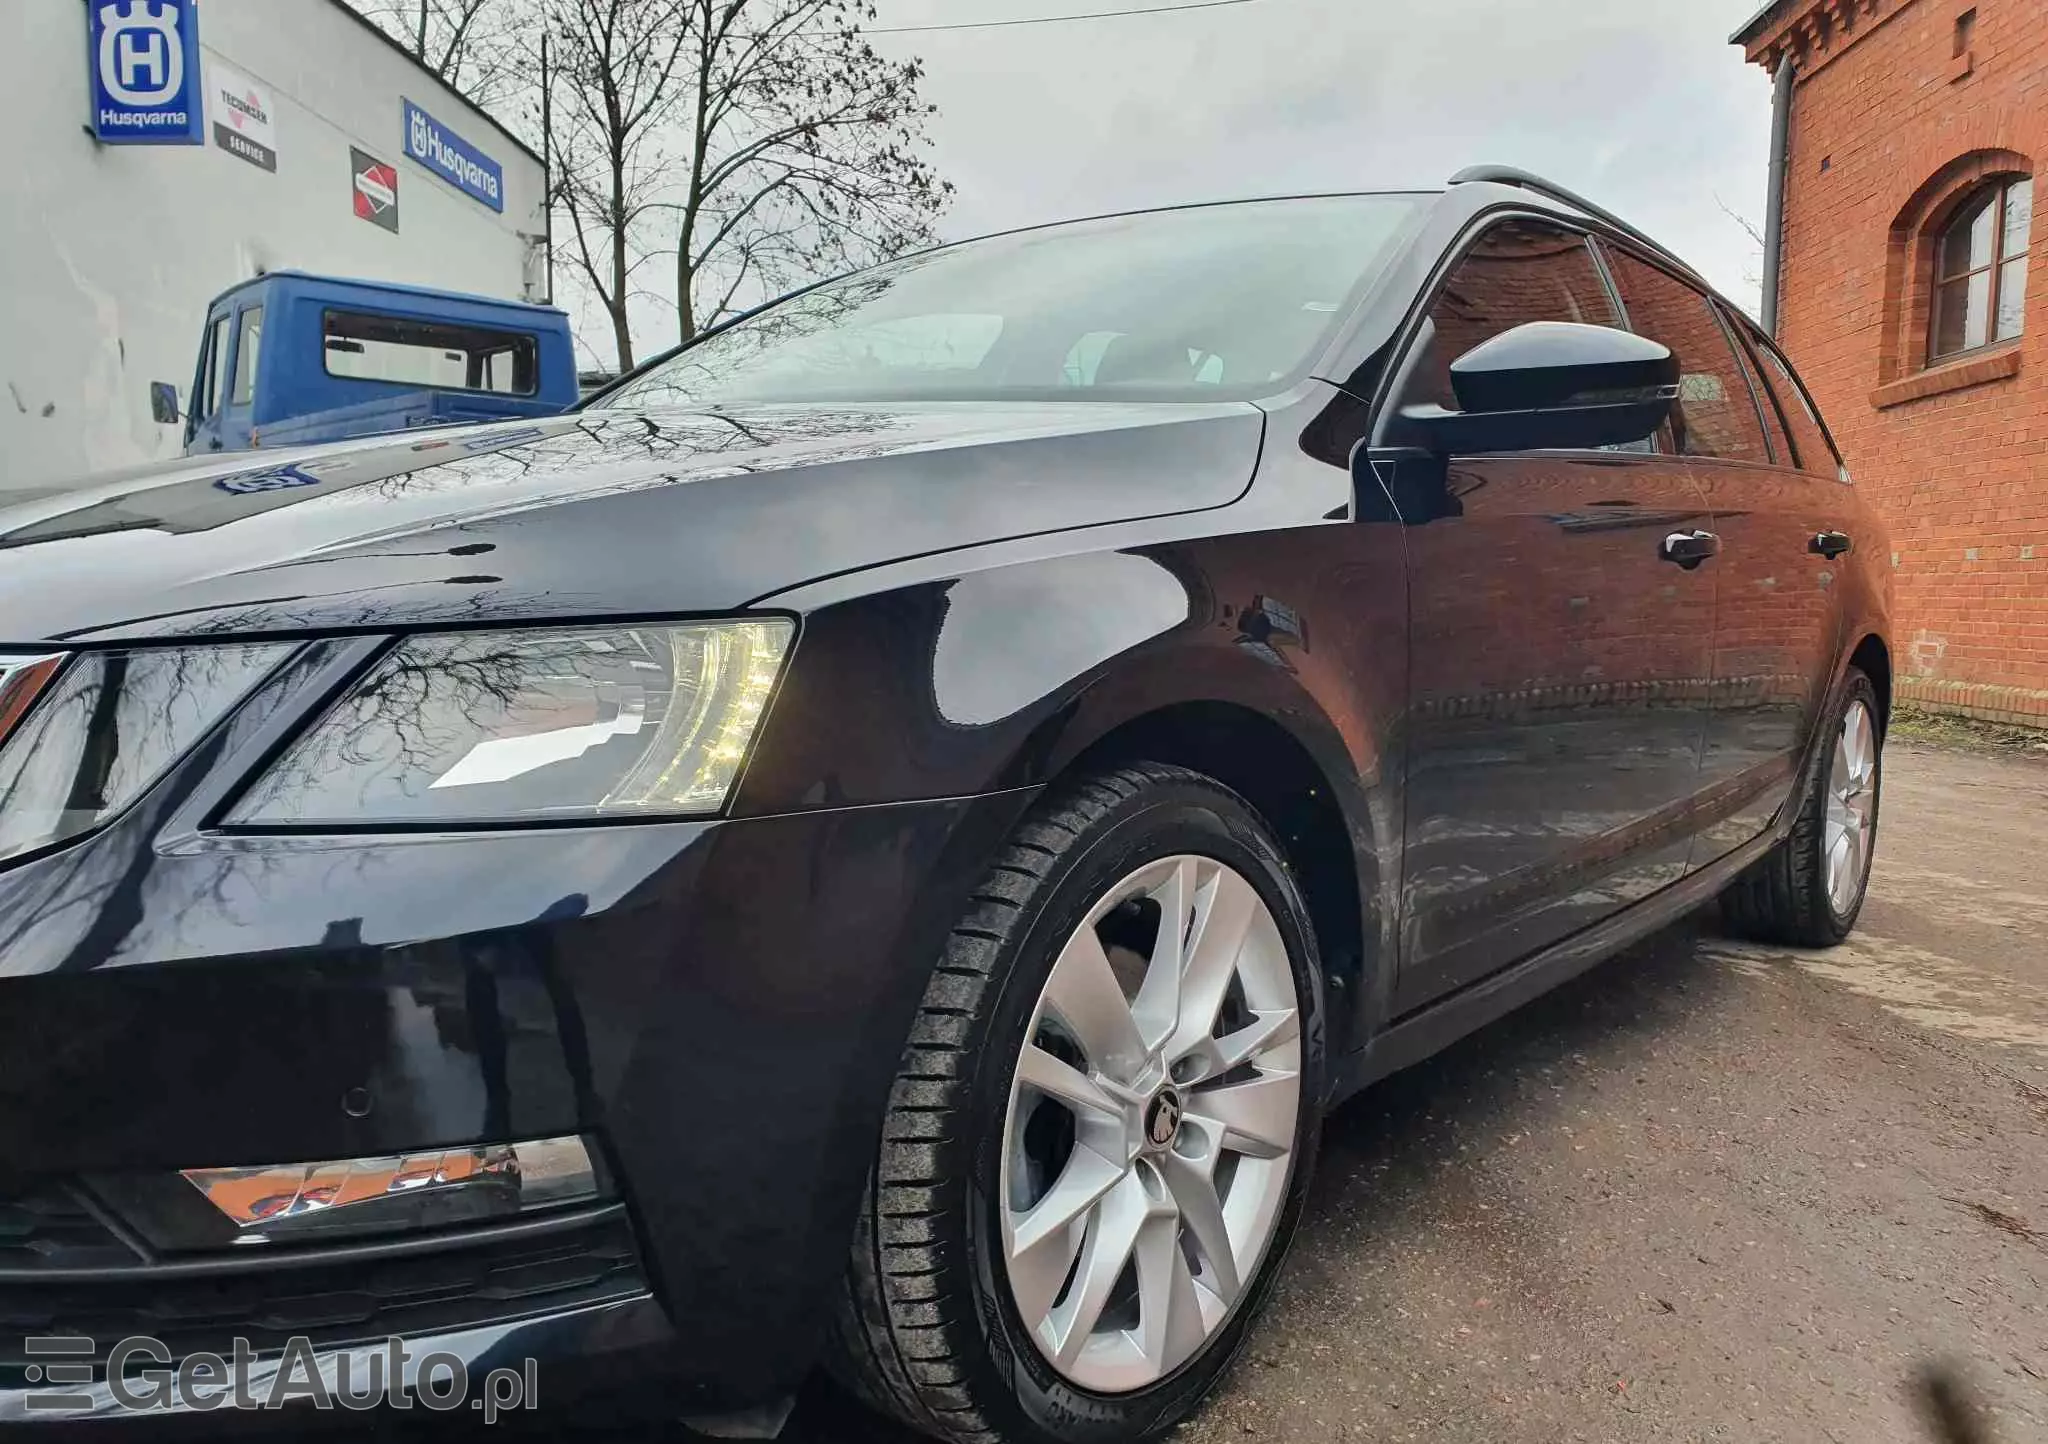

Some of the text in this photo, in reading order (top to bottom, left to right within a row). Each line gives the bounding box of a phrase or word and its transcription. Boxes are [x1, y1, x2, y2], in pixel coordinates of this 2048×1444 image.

[100, 109, 187, 128] Husqvarna
[230, 135, 264, 162] SERVICE
[427, 125, 498, 199] Husqvarna
